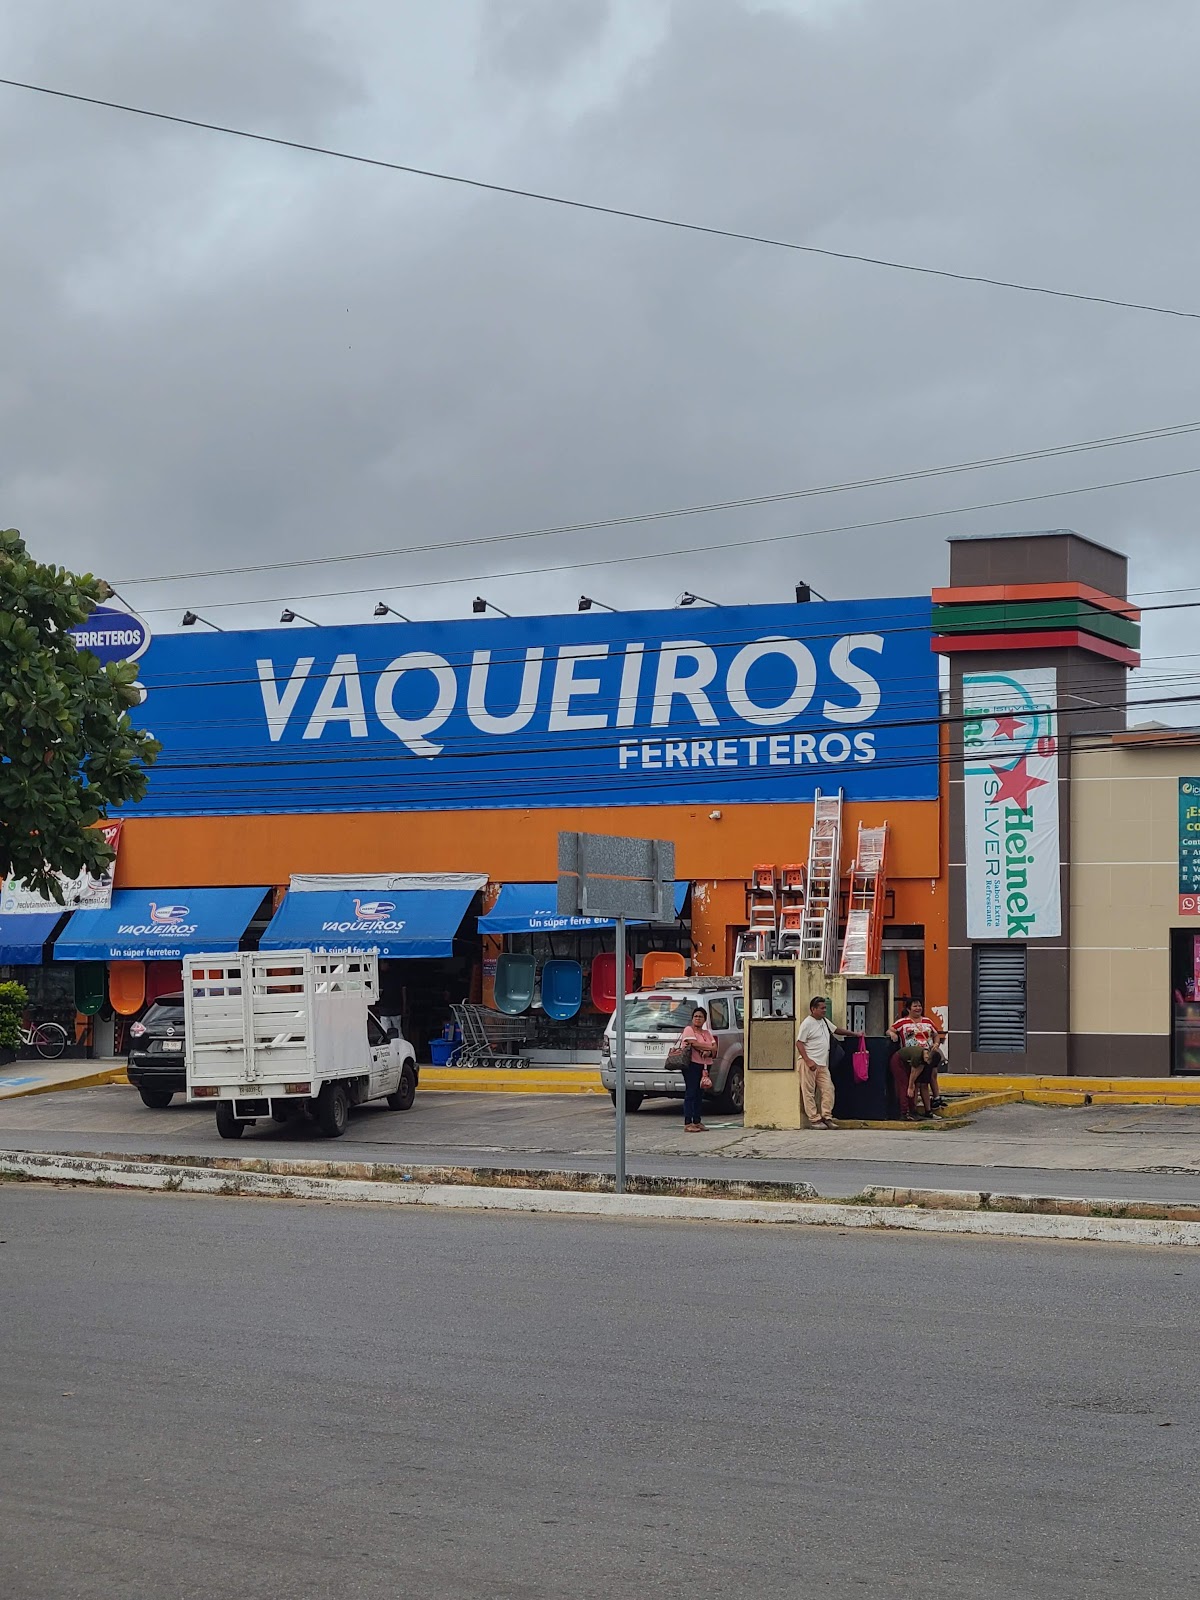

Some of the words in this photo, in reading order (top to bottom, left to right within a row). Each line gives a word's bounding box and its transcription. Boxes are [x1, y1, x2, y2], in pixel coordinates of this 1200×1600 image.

[256, 633, 884, 761] VAQUEIROS
[619, 732, 876, 769] FERRETEROS
[984, 780, 1001, 876] SILVER
[1004, 805, 1036, 938] Heinek
[117, 924, 198, 936] VAQUEIROS
[322, 921, 406, 933] VAQUEIROS
[529, 919, 541, 928] Un
[544, 917, 567, 928] súper
[110, 947, 122, 957] Un
[123, 946, 145, 959] súper
[146, 947, 181, 957] ferretero
